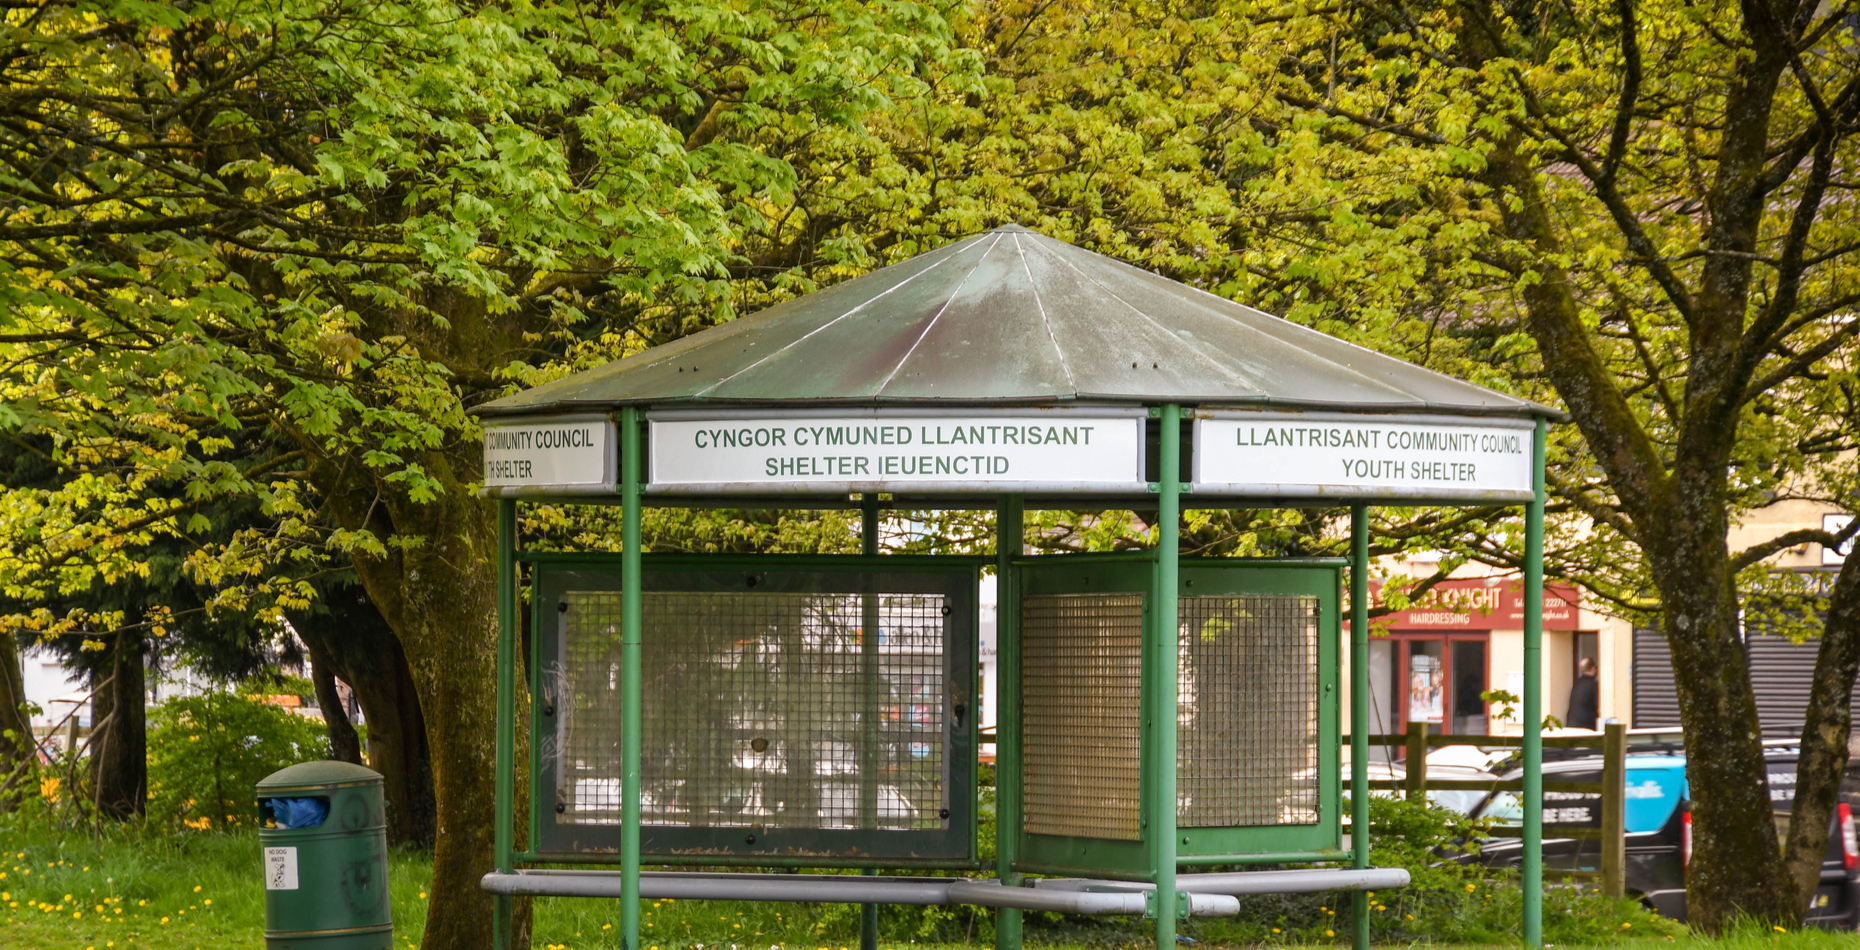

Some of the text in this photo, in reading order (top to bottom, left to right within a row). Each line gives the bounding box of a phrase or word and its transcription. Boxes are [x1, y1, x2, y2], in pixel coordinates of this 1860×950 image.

[489, 431, 533, 450] COMMUNITY
[536, 429, 594, 448] COUNCIL
[694, 426, 1095, 449] CYNGOR CYMUNED LLANTRISANT
[1236, 427, 1523, 455] LLANTRISANT COMMUNITY COUNCIL
[495, 460, 533, 479] SHELTER
[765, 456, 1010, 476] SHELTER IEUENCTID
[1342, 458, 1476, 482] YOUTH SHELTER
[1442, 587, 1502, 610] KNIGHT
[1410, 613, 1470, 625] HAIRDRESSING
